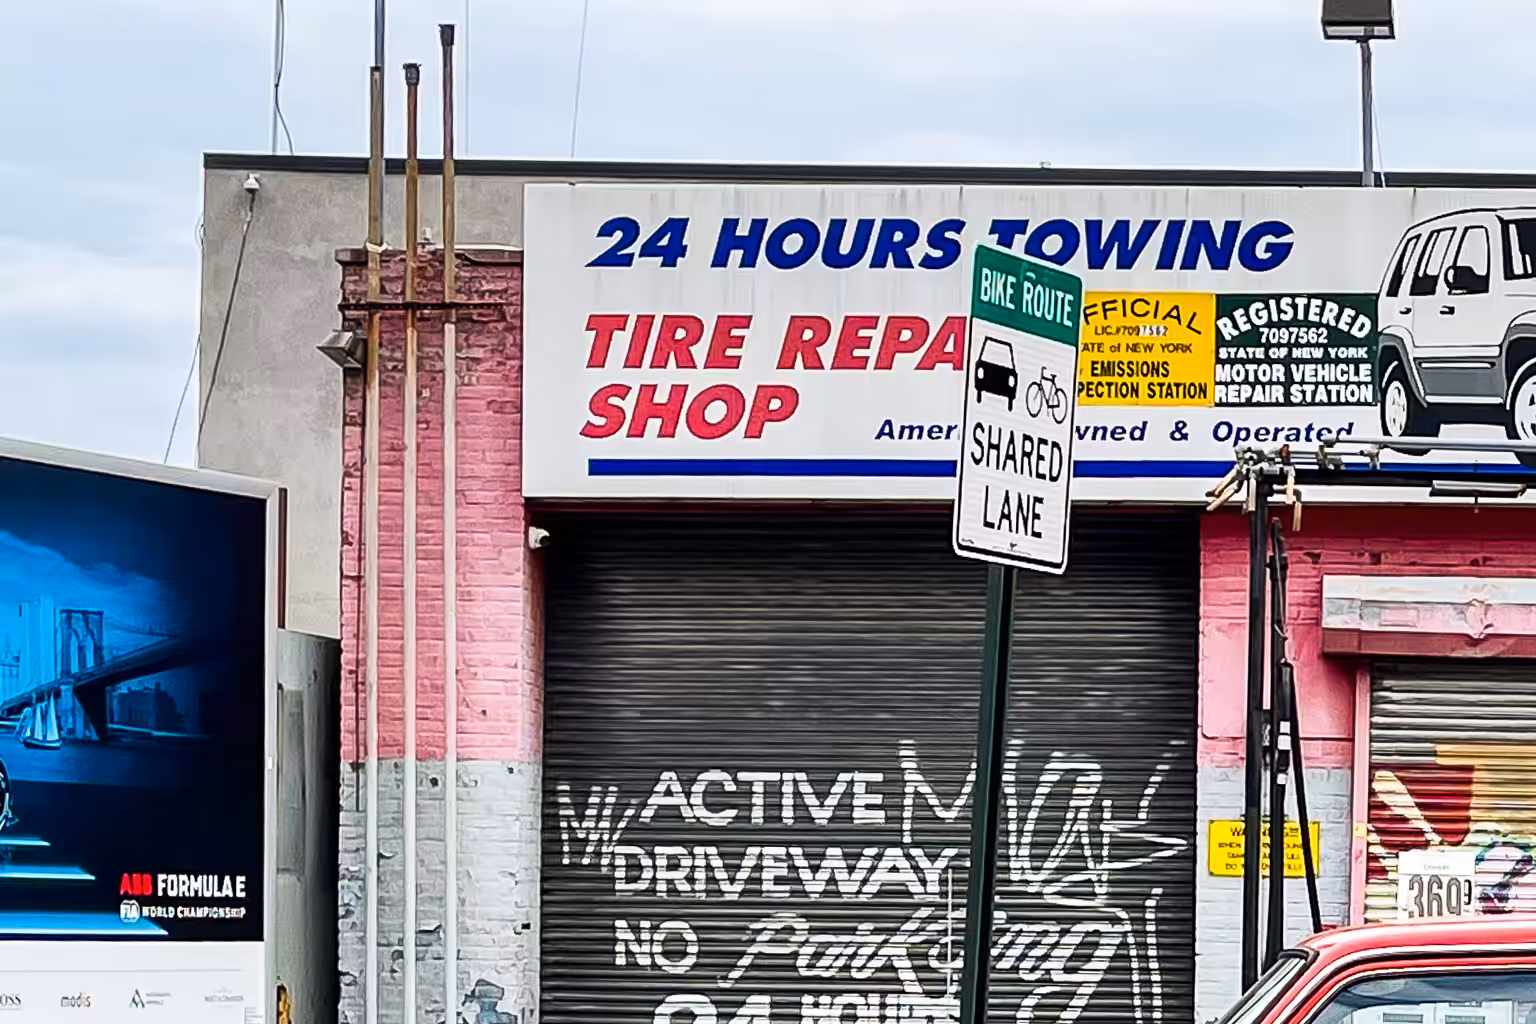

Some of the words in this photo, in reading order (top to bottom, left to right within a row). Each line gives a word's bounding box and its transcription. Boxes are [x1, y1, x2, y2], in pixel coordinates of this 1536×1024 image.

[584, 217, 690, 269] 24
[710, 217, 967, 270] HOURS
[988, 218, 1295, 272] TOWING
[980, 267, 1016, 311] BIKE
[1021, 279, 1074, 329] ROUTE
[1082, 297, 1202, 336] FFICIAL
[1216, 296, 1372, 341] REGISTERED
[1259, 327, 1329, 345] 7097562
[585, 314, 753, 370] TIRE
[775, 314, 965, 371] REPA
[1081, 342, 1105, 353] ATE
[1126, 343, 1154, 353] NEW
[1159, 343, 1193, 354] YORK
[1218, 347, 1265, 359] STATE
[1291, 347, 1323, 359] NEW
[1327, 347, 1369, 359] YORK
[1090, 360, 1170, 378] EMISSIONS
[1214, 363, 1286, 383] MOTOR
[1290, 364, 1372, 383] VEHICLE
[1077, 381, 1140, 400] PECTION
[1147, 382, 1208, 400] STATION
[1214, 384, 1285, 404] REPAIR
[1289, 384, 1373, 404] STATION
[580, 383, 800, 440] SHOP
[875, 419, 957, 442] Amer
[1170, 420, 1190, 442] &
[1212, 419, 1355, 448] Operated
[971, 421, 1064, 484] SHARED
[982, 486, 1044, 540] LANE
[638, 769, 887, 826] ACTIVE
[156, 873, 234, 898] FORMULA
[235, 875, 247, 898] E
[613, 844, 958, 900] DRIVEWAY
[141, 905, 176, 919] WORLD
[176, 905, 247, 919] CHAMPIONSHIP
[614, 918, 700, 975] NO
